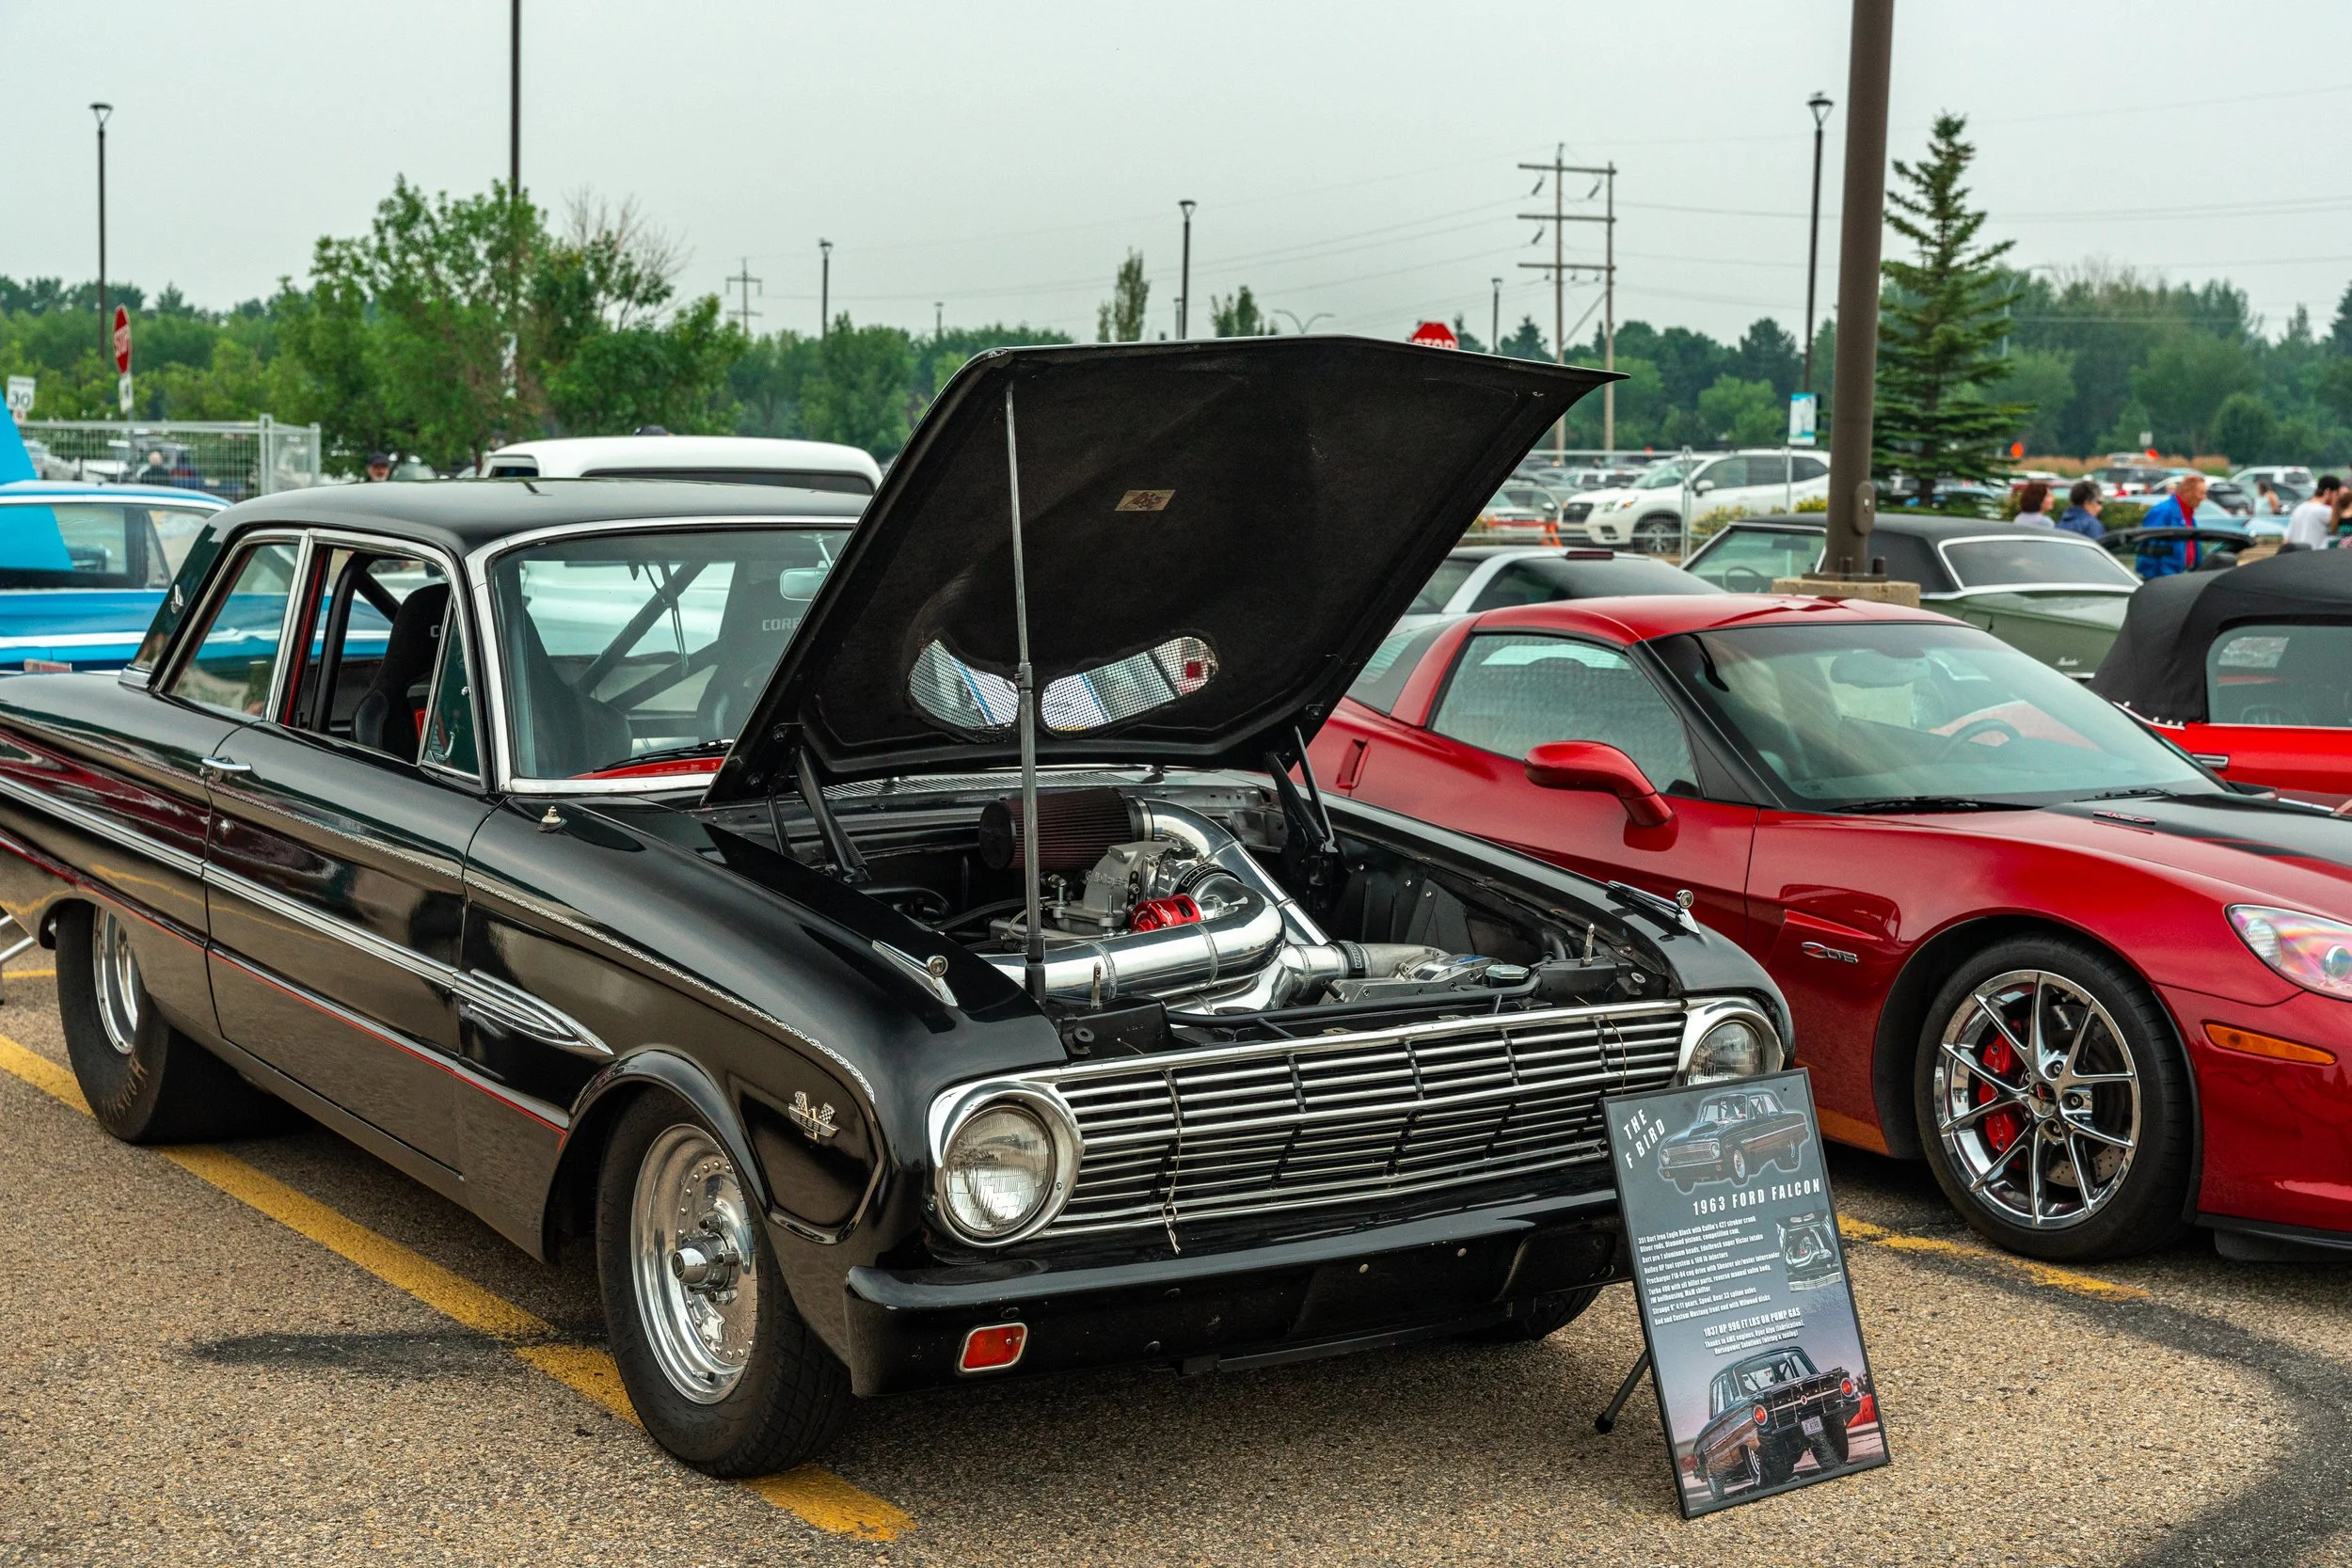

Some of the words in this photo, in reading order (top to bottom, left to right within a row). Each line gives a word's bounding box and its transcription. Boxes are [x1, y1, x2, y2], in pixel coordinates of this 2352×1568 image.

[1624, 1109, 1647, 1140] THE
[1626, 1152, 1633, 1169] F
[1635, 1119, 1665, 1158] BIRD
[1693, 1197, 1725, 1215] 1963
[1732, 1190, 1764, 1208] FORD
[1772, 1180, 1820, 1200] FALCON
[1665, 1239, 1683, 1247] Diamond
[1703, 1230, 1728, 1240] competition
[1663, 1249, 1685, 1259] aluminum
[1700, 1242, 1722, 1251] Edelbrock
[1675, 1259, 1690, 1268] system
[1646, 1275, 1670, 1285] Procharger
[1713, 1273, 1730, 1281] reverse
[1730, 1270, 1746, 1278] manual
[1652, 1306, 1669, 1315] Strange
[1730, 1290, 1743, 1298] spline
[1673, 1312, 1689, 1322] Custom
[1690, 1308, 1708, 1318] Mustang
[1703, 1326, 1718, 1337] 1037
[1719, 1323, 1726, 1334] HP
[1727, 1321, 1740, 1332] 996
[1740, 1319, 1748, 1328] FT
[1748, 1317, 1760, 1326] LBS
[1760, 1314, 1770, 1323] ON
[1770, 1310, 1788, 1322] PUMP
[1788, 1307, 1800, 1318] GAS
[1705, 1338, 1720, 1348] Thanks
[1740, 1338, 1761, 1349] Solutions
